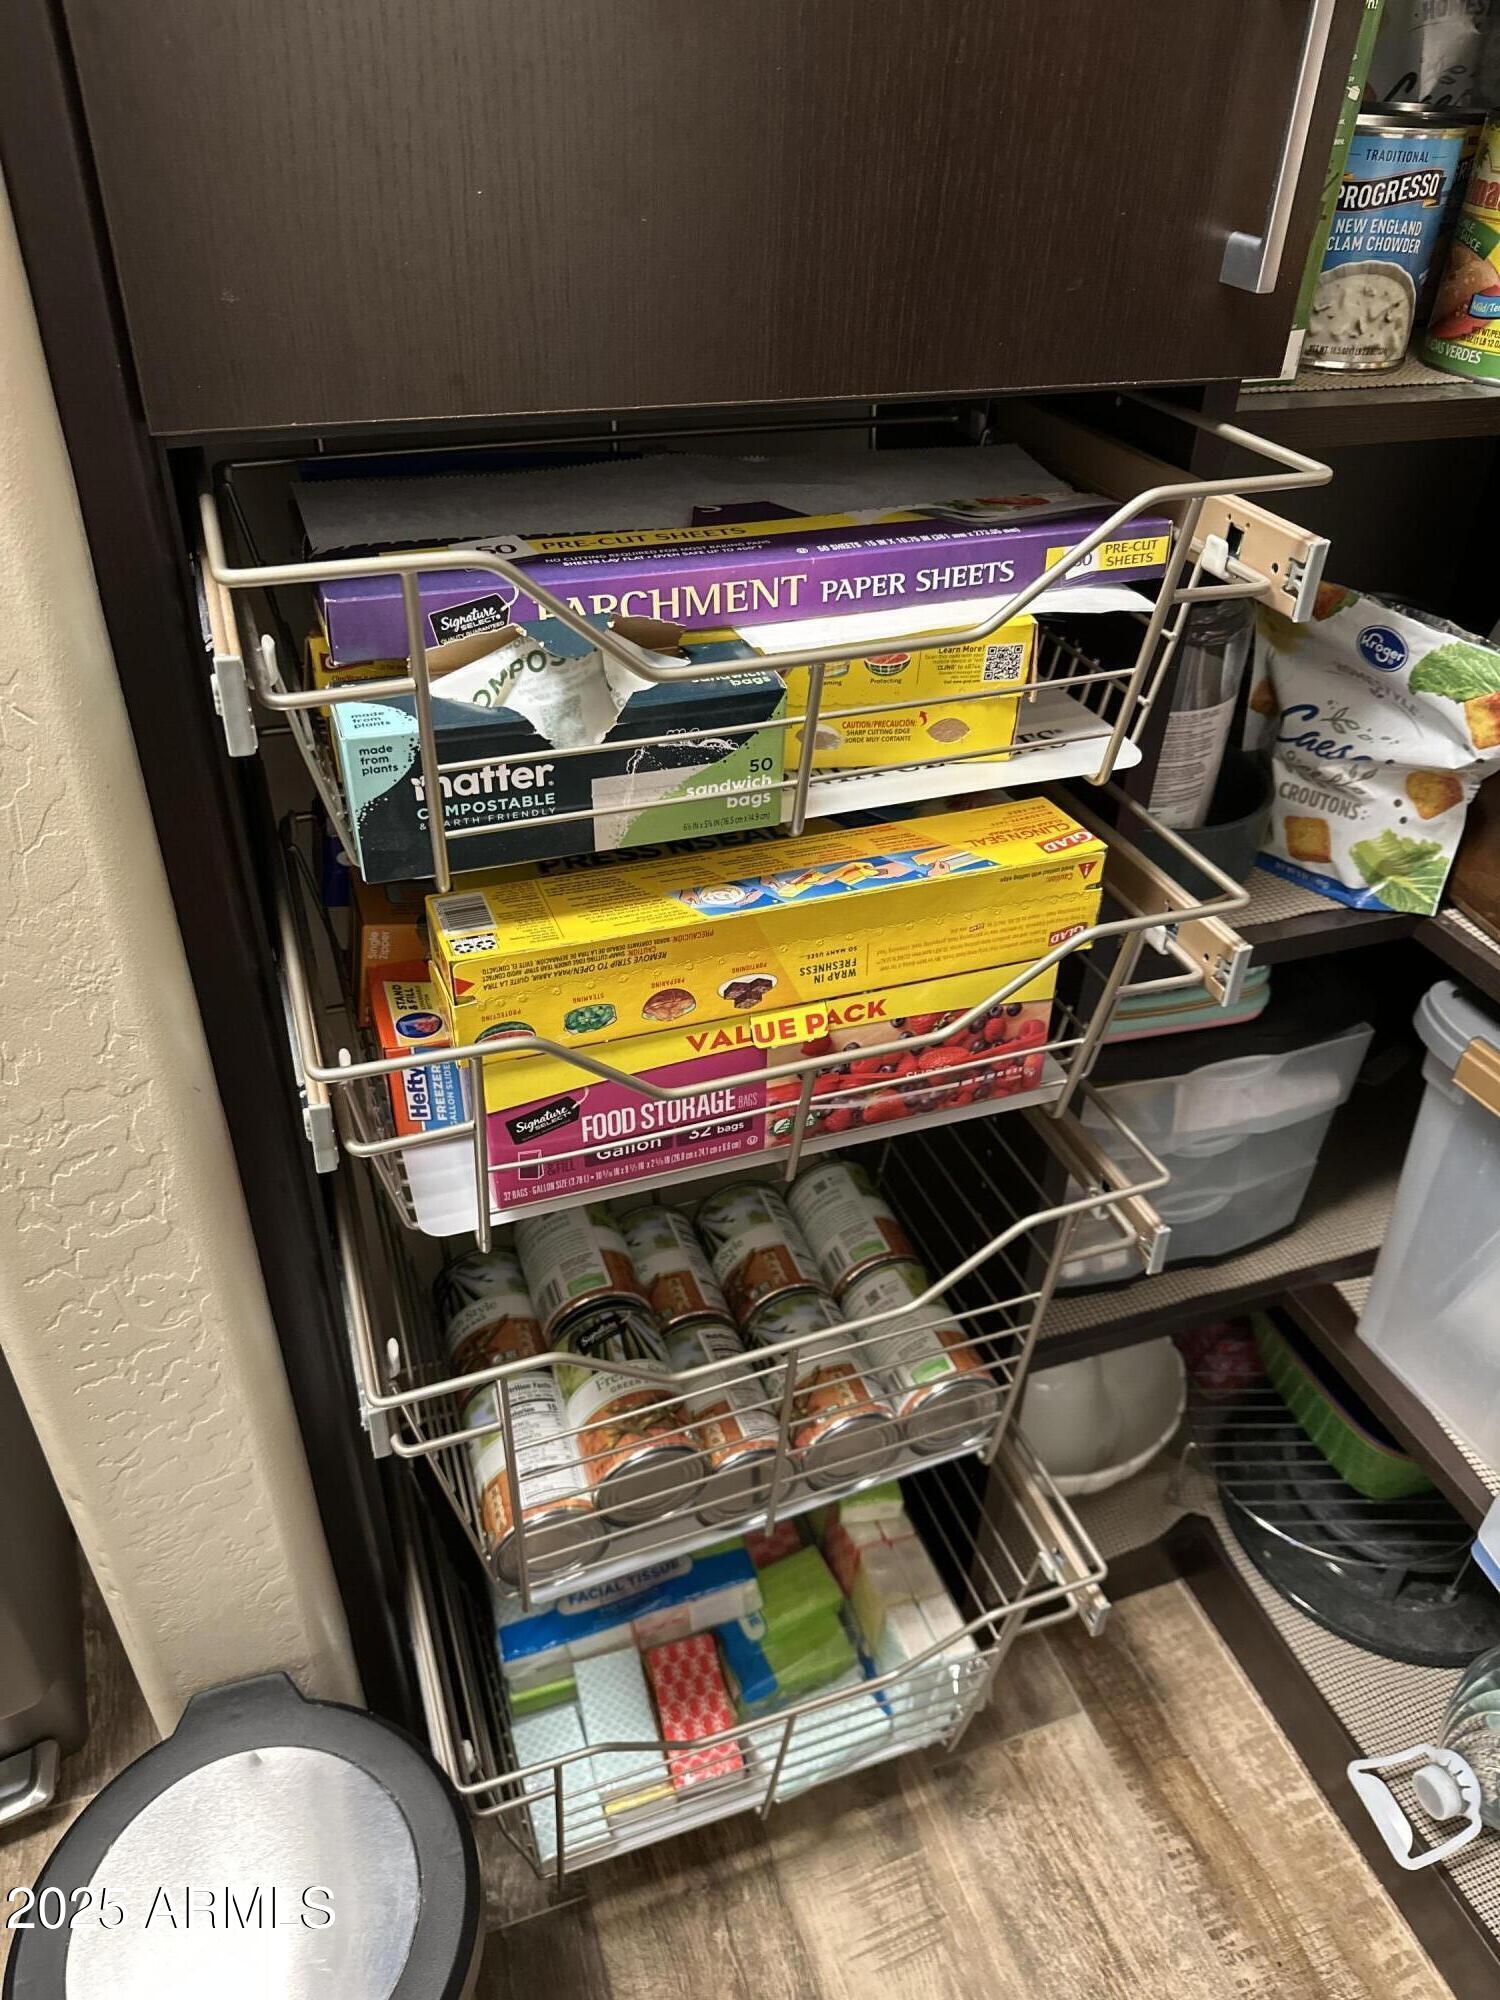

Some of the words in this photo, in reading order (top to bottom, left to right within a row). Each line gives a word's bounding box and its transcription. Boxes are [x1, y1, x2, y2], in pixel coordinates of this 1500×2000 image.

[1366, 149, 1430, 163] TRADITIONAL
[1335, 218, 1368, 234] NEW
[1369, 219, 1422, 236] ENGLAND
[1327, 236, 1365, 251] CLAM
[1366, 236, 1421, 254] CHOWDER
[1445, 346, 1482, 364] VERDES
[475, 543, 518, 555] 50
[540, 534, 647, 551] PRE-CUT
[655, 527, 747, 541] SHEETS
[1105, 539, 1159, 554] PRE-CUT
[1106, 552, 1154, 567] SHEETS
[821, 573, 906, 603] PAPER
[915, 560, 1015, 593] SHEETS
[441, 607, 497, 632] Signature
[460, 615, 496, 631] SELECT
[963, 645, 986, 653] More!
[1360, 633, 1405, 663] Kroger
[730, 676, 772, 687] bags
[870, 678, 902, 686] Protecting
[354, 721, 391, 729] plants
[882, 735, 911, 743] CORTANTE
[359, 745, 392, 756] made
[360, 755, 389, 766] from
[750, 757, 773, 773] 50
[362, 764, 398, 776] plants
[686, 775, 773, 798] sandwich
[417, 793, 556, 820] CMPOSTABLE
[727, 791, 772, 809] bags
[1280, 782, 1361, 820] CROUTONS
[419, 823, 427, 831] &
[488, 807, 556, 822] FRIENDLY
[1043, 831, 1093, 852] GLAD
[1051, 926, 1085, 944] GLAD
[610, 957, 631, 968] STRIP
[633, 952, 667, 963] REMOVE
[800, 958, 857, 976] FRESHNESS
[828, 969, 856, 981] WRAP
[510, 976, 529, 985] QUITE
[651, 977, 685, 988] PREPARING
[814, 975, 824, 984] IN
[392, 985, 407, 1010] STAND
[405, 988, 417, 1004] FILL
[572, 993, 605, 1003] STEAMING
[481, 1008, 521, 1022] PROTECTING
[686, 1017, 797, 1052] VALUE
[806, 999, 887, 1035] PACK
[443, 1064, 454, 1090] SLIDE
[407, 1067, 428, 1118] Hefty
[431, 1064, 447, 1120] FREEZER
[516, 1107, 568, 1133] Signature
[581, 1104, 635, 1143] FOOD
[641, 1089, 736, 1131] STORAGE
[738, 1092, 758, 1110] BAGS
[717, 1121, 745, 1135] bags
[503, 1192, 511, 1201] 32
[512, 1188, 528, 1200] BAGS
[532, 1182, 555, 1195] GALLON
[555, 1179, 567, 1189] SIZE
[568, 1583, 626, 1606] FACIAL
[628, 1559, 680, 1587] TISSUE
